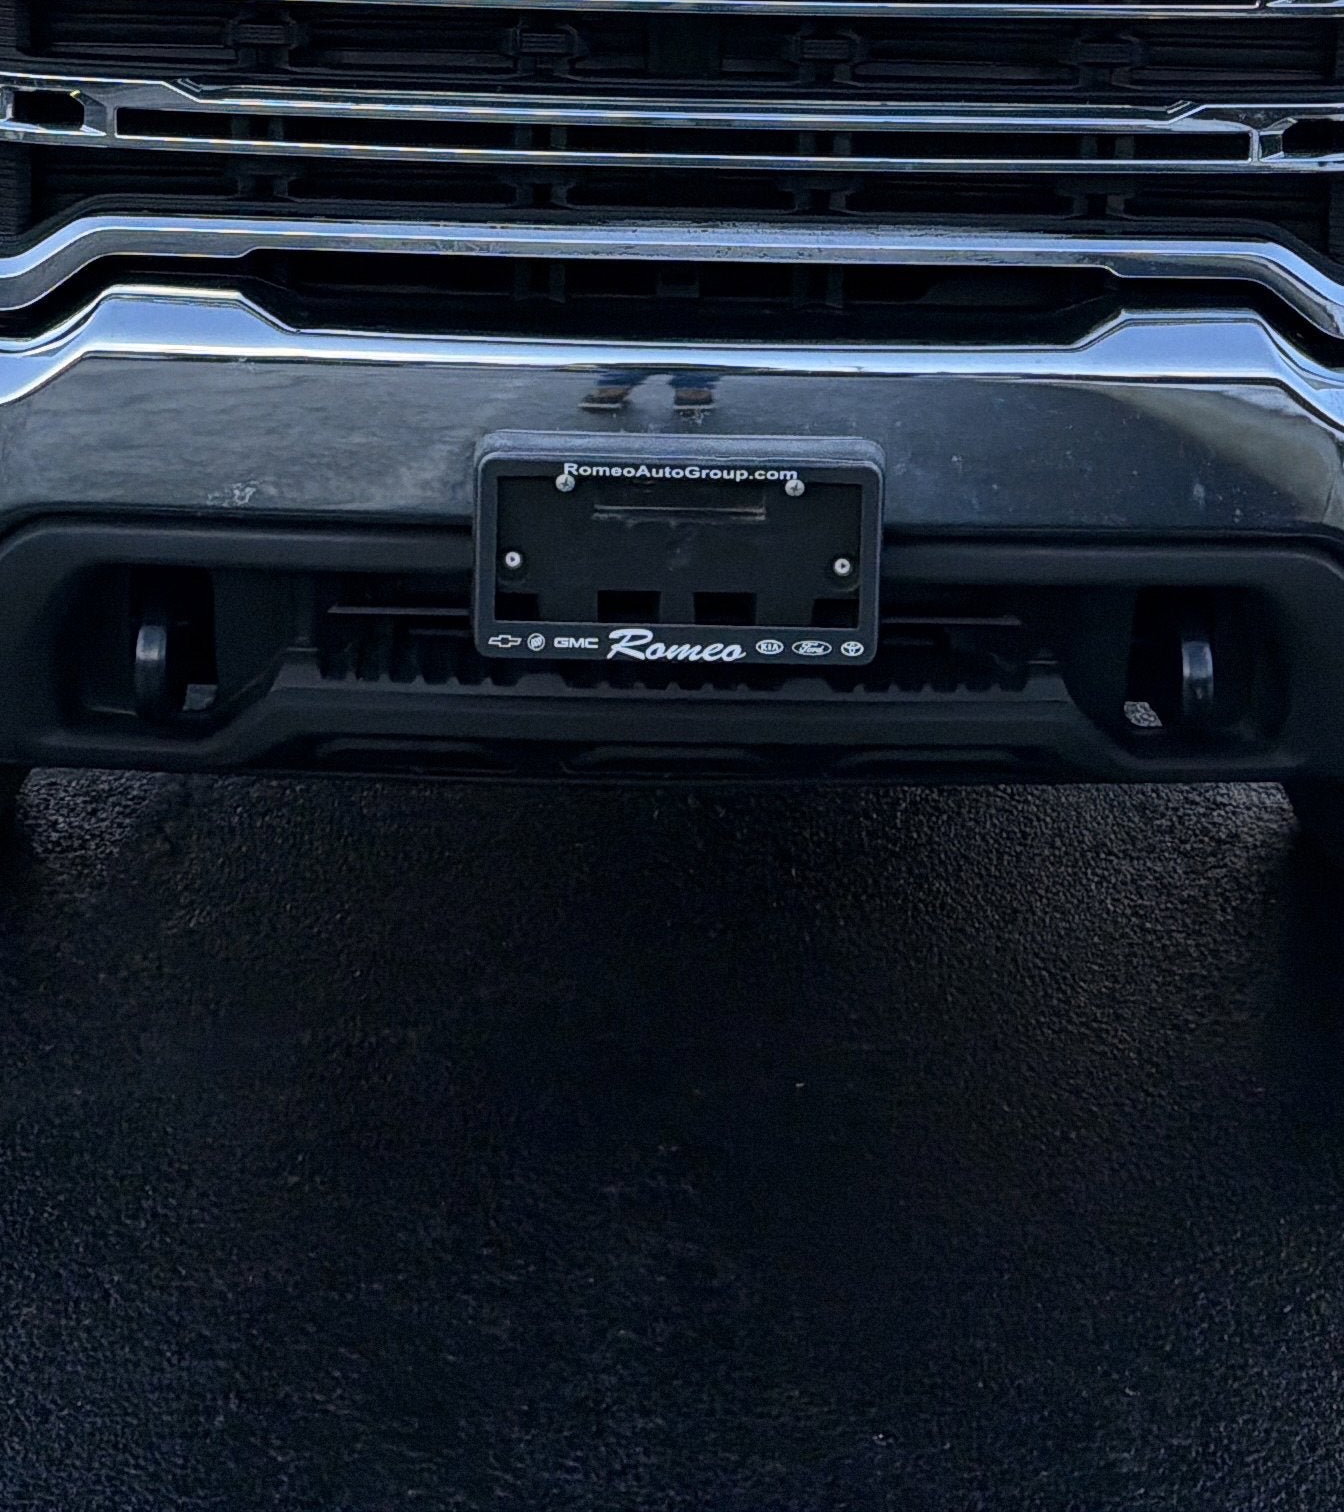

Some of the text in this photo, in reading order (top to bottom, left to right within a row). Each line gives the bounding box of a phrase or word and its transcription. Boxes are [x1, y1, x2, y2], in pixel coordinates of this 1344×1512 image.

[563, 462, 798, 482] RomeoAutoGroup.com
[553, 628, 827, 662] GMC Romeo KIA Ford
